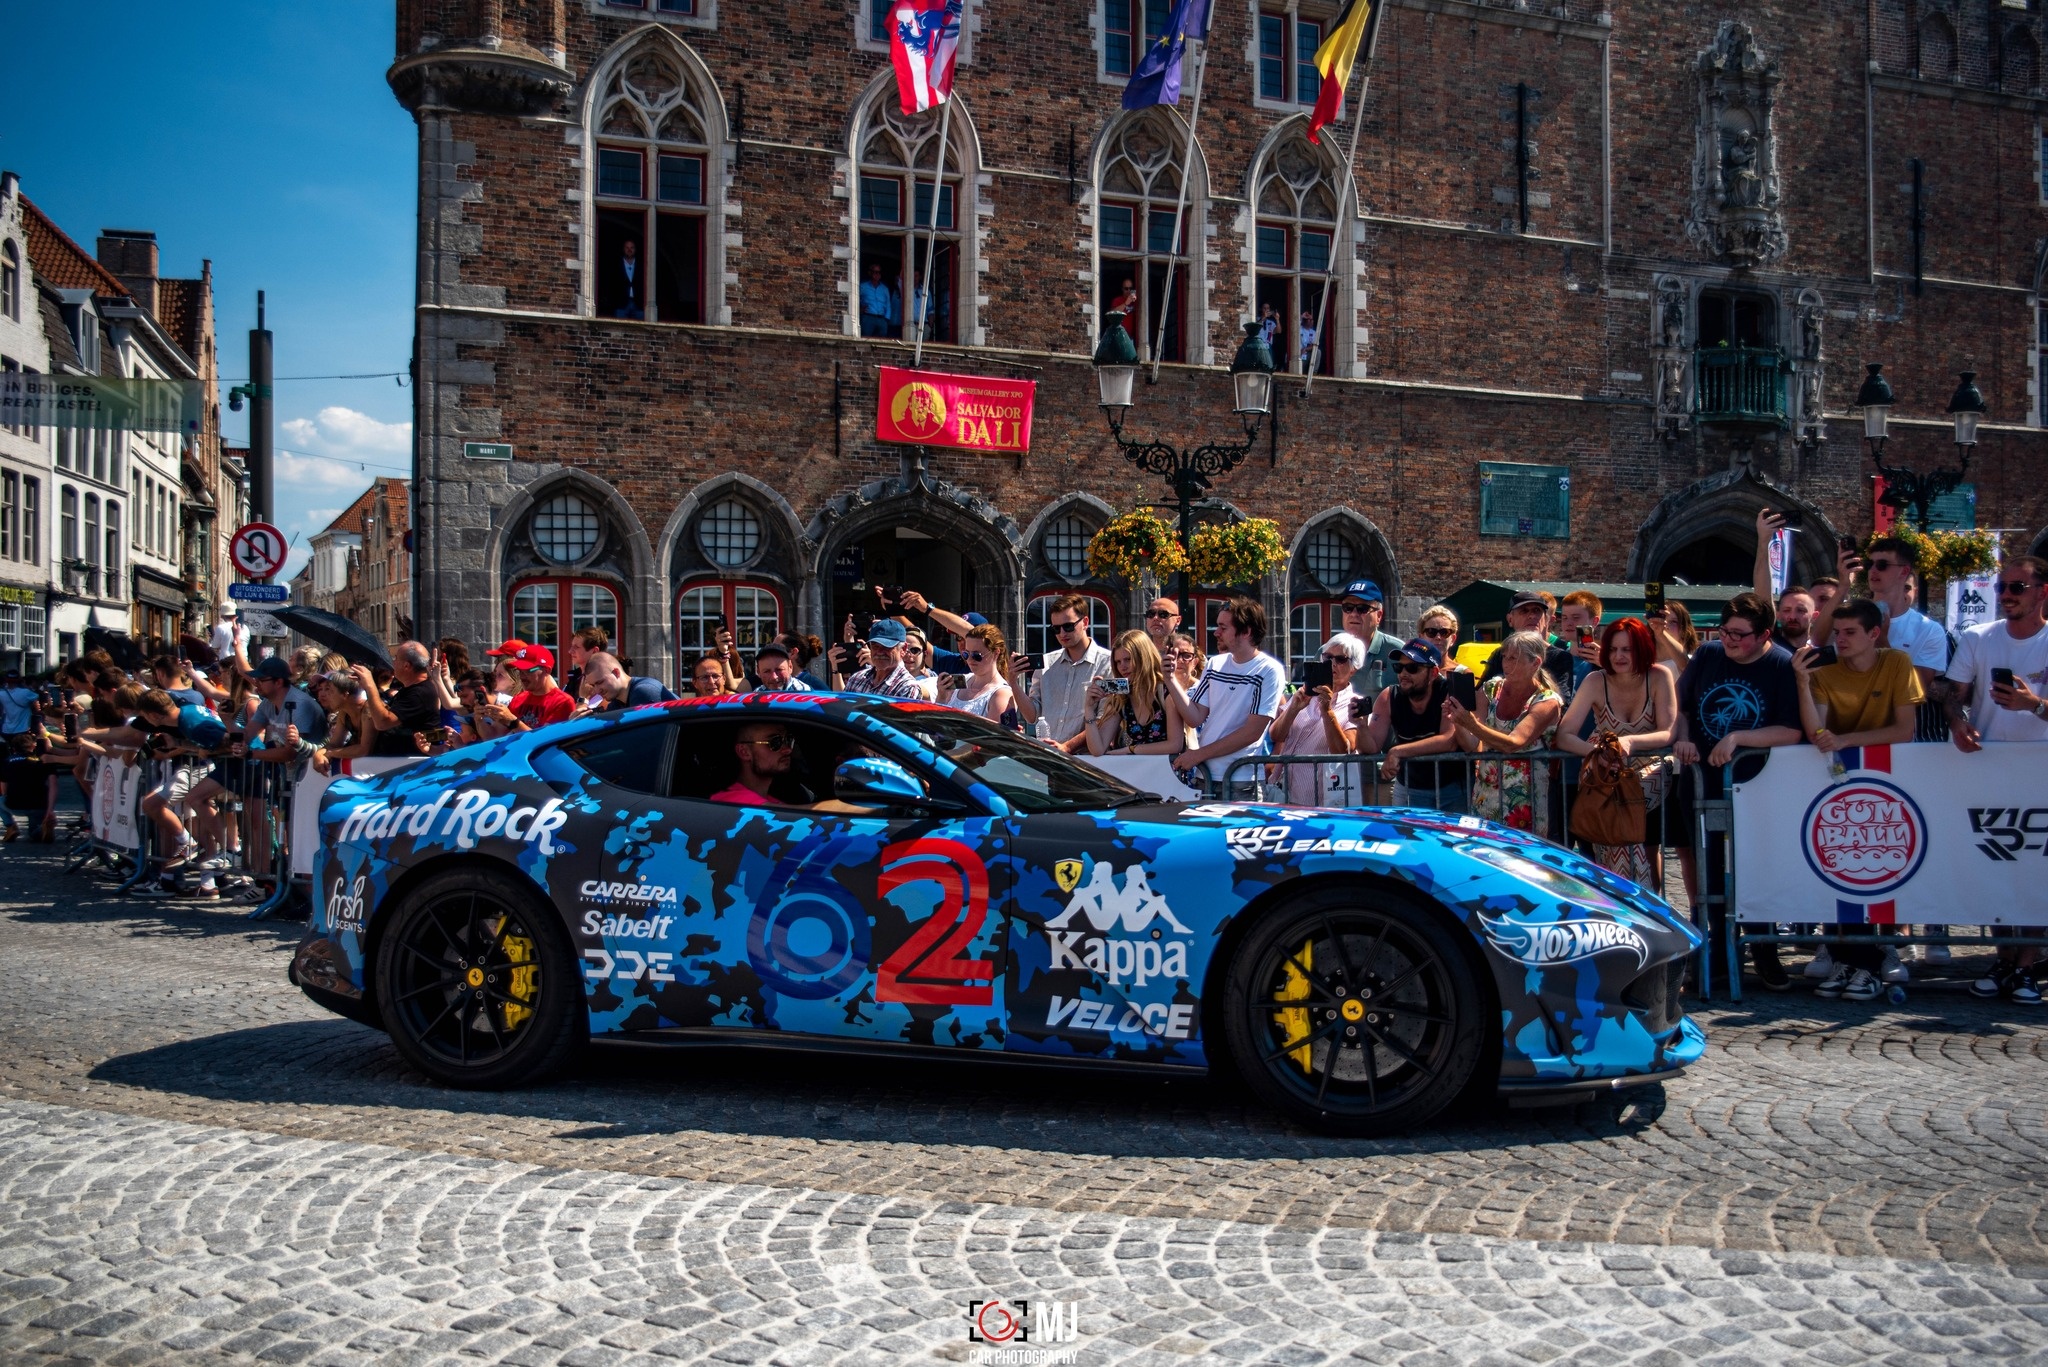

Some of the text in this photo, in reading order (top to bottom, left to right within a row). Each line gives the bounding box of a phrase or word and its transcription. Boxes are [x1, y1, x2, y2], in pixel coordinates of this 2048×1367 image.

[0, 397, 102, 411] REAT TASTE!
[958, 387, 1023, 399] MUSEUM GALLERY XPO
[956, 402, 1021, 419] SALVADOR
[956, 417, 1022, 448] DALI
[235, 585, 281, 594] UITGEZONDERD
[1959, 604, 1985, 615] Kappa
[338, 789, 568, 856] Hard Rock
[1819, 798, 1905, 825] GUM
[1818, 824, 1908, 848] BALL
[1820, 847, 1908, 873] 3000
[579, 896, 620, 905] EYEWEAR
[625, 900, 651, 908] SINCE
[581, 880, 677, 903] CARRERA
[335, 919, 363, 933] SCENTS
[581, 910, 673, 940] Sabelt
[747, 835, 994, 1006] 62
[584, 948, 676, 981] DDE
[1045, 930, 1190, 986] Kappa
[1045, 995, 1194, 1038] VELOCE
